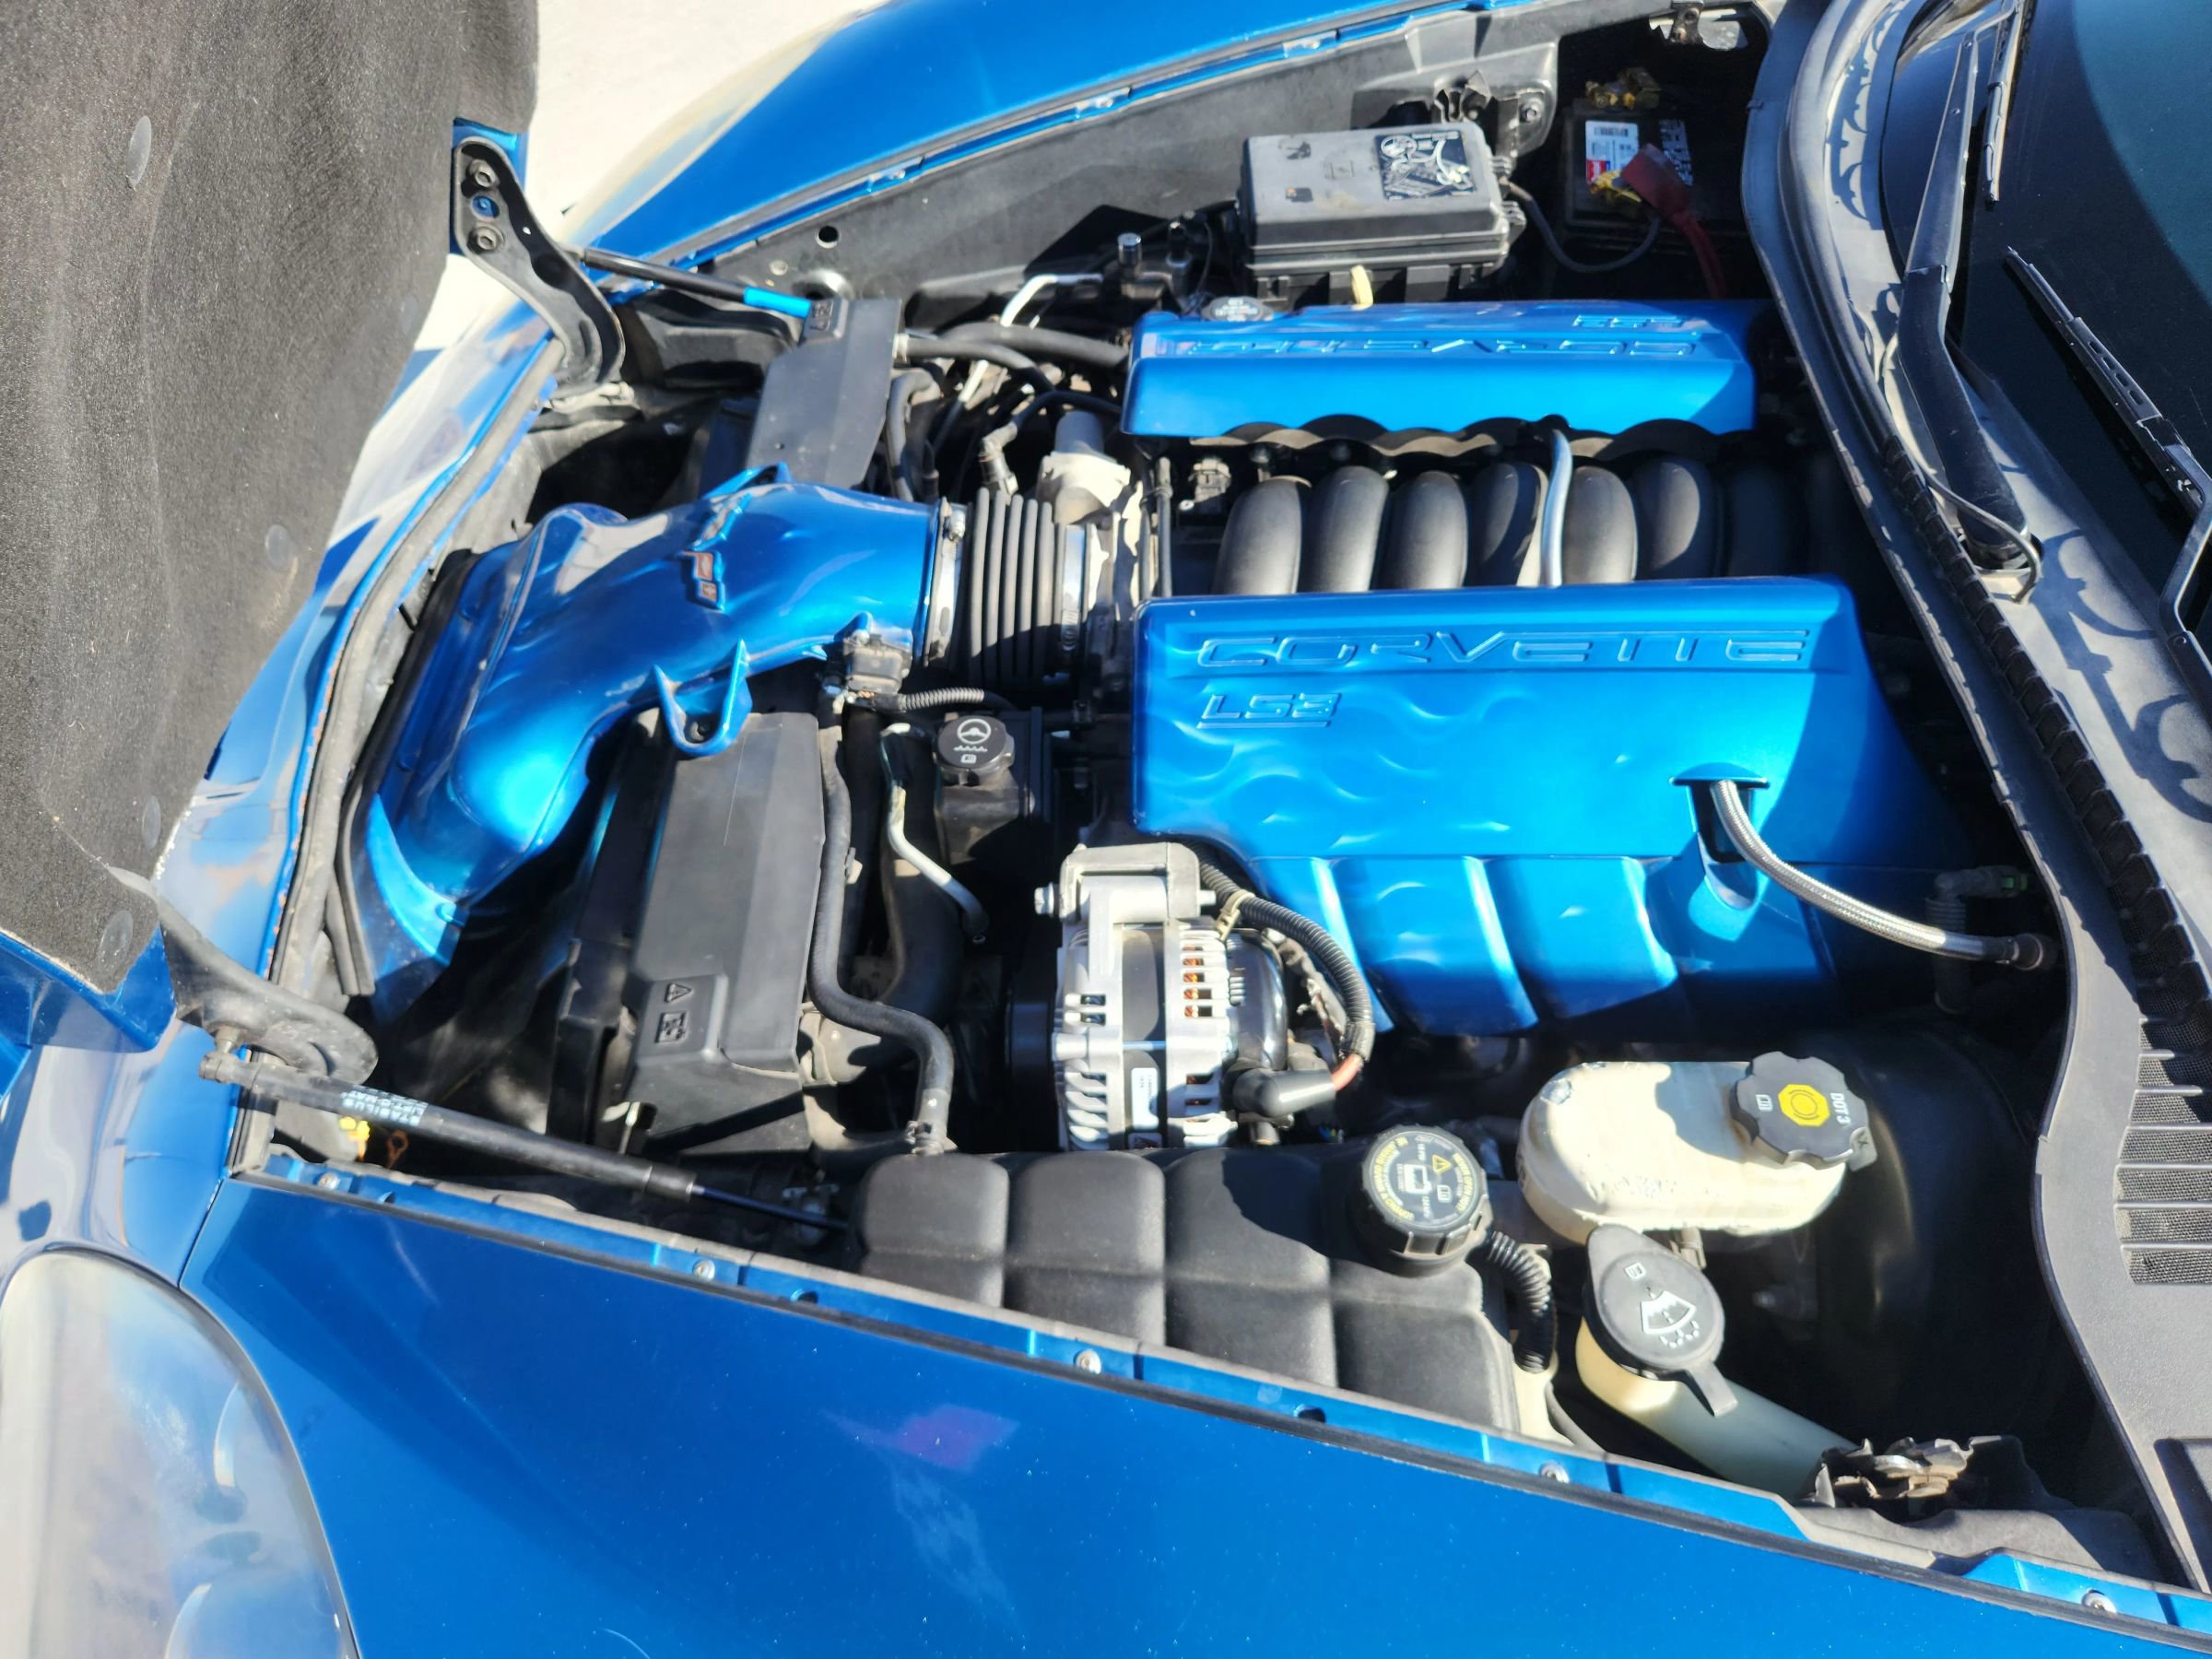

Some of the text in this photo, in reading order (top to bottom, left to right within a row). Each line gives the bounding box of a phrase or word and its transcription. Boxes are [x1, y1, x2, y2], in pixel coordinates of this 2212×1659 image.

[1198, 630, 1809, 665] CORVETTE
[1201, 693, 1342, 719] LS3
[342, 1098, 421, 1126] STABILUS
[1830, 1092, 1848, 1116] DOT
